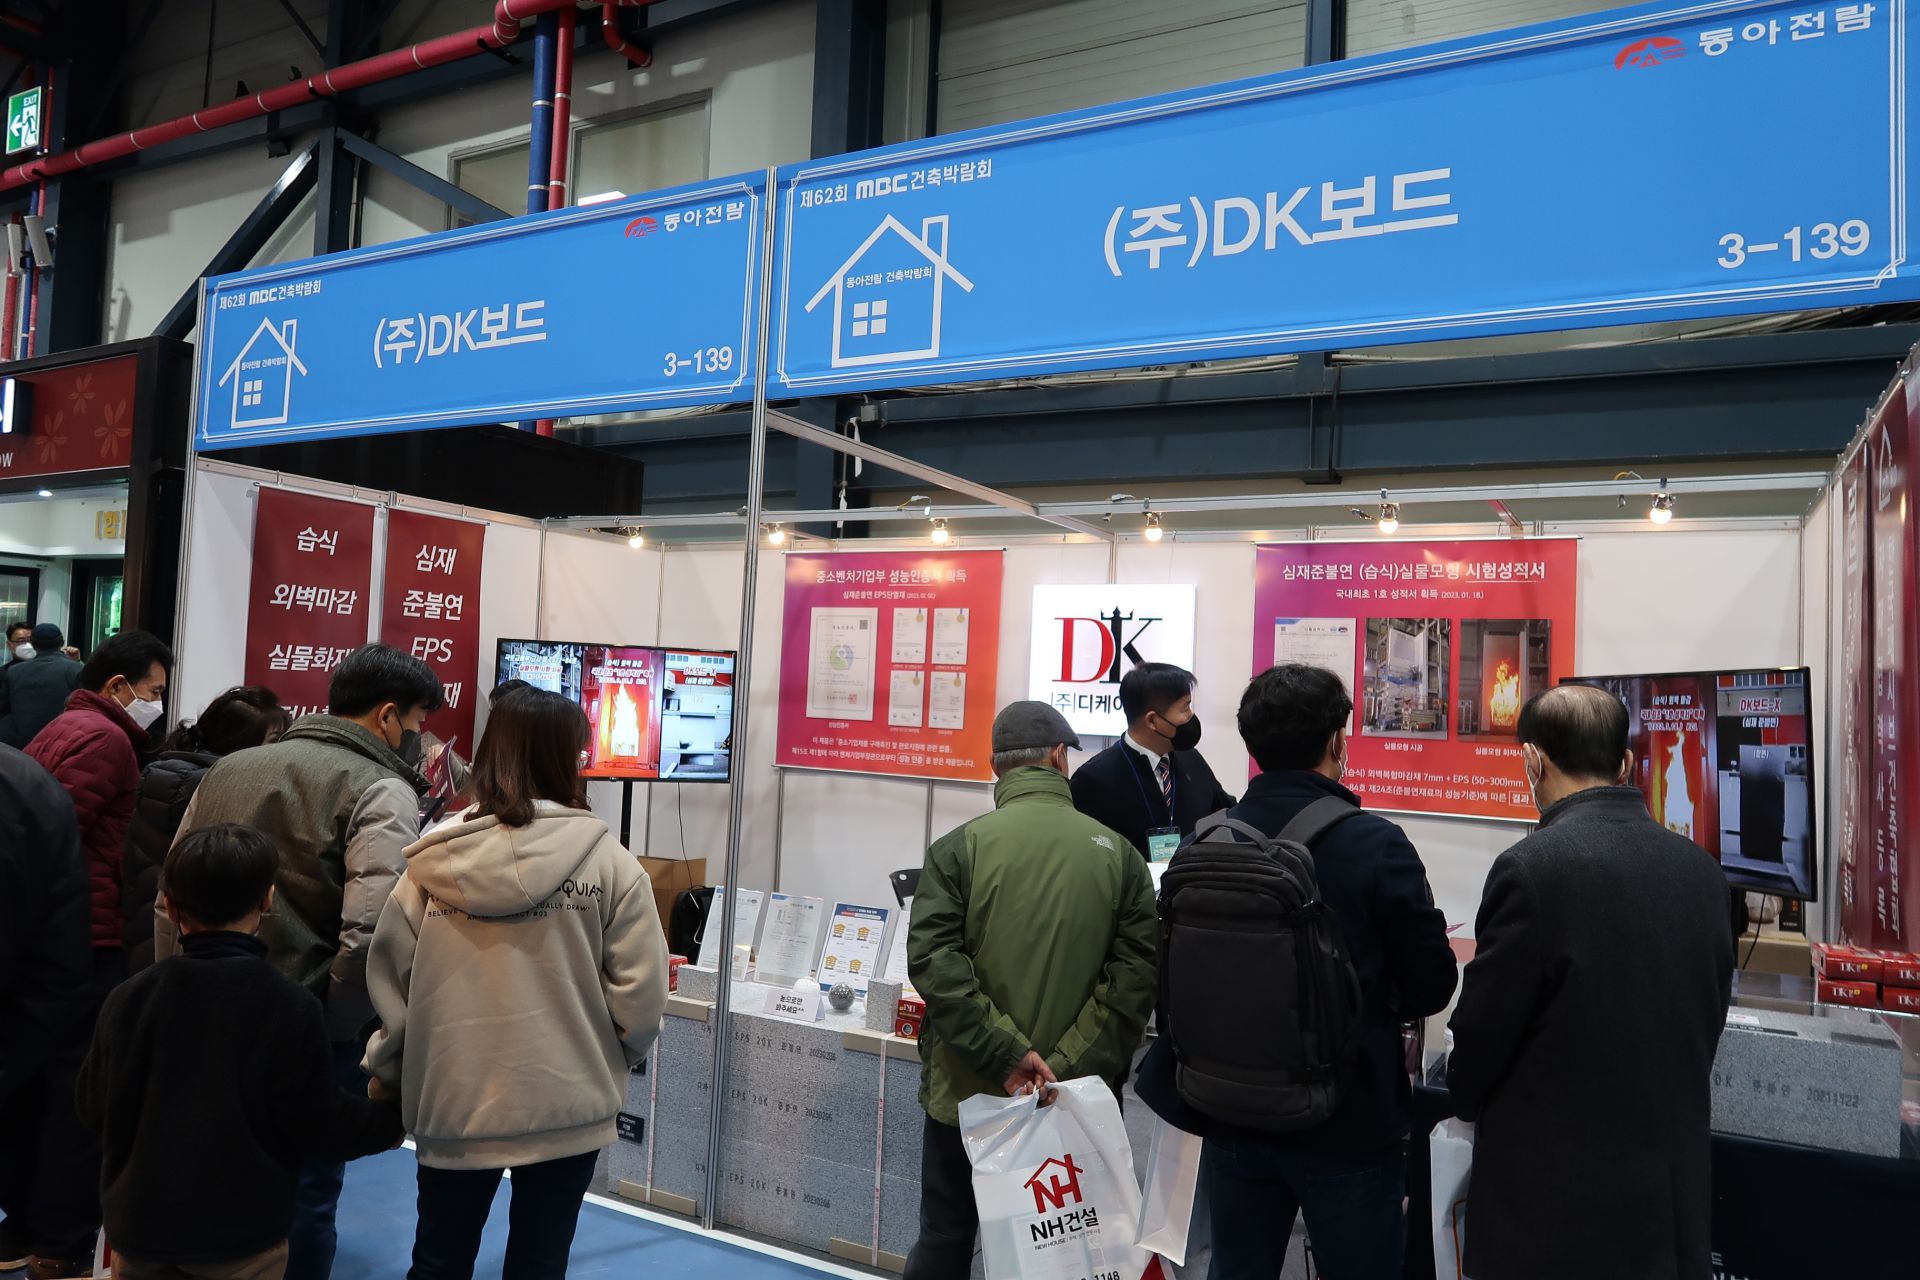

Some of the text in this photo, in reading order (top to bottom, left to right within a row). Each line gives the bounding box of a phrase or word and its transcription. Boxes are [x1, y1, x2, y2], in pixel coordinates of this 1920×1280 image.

[1697, 3, 1876, 57] 동아전람
[23, 94, 38, 107] EXIT
[800, 184, 848, 209] 제62회
[664, 203, 745, 232] 동아전람
[1102, 166, 1459, 278] (주)DK보드
[1717, 219, 1872, 269] 3-139
[846, 265, 933, 289] 동아전람 건축박람회
[219, 293, 246, 309] 제62회
[373, 300, 548, 369] (주)DK보드
[664, 346, 734, 377] 3-139
[297, 526, 339, 555] 습식
[415, 544, 457, 575] 심재
[1282, 561, 1546, 581] 심재준불연 (습식)실물모형 시험성적서
[816, 569, 886, 584] 중소벤처기업부
[269, 583, 358, 615] 외벽마감
[402, 589, 464, 621] 준불연
[1335, 588, 1370, 600] 국내최초
[1374, 588, 1387, 600] 1호
[1390, 588, 1417, 600] 성적서
[410, 636, 453, 663] EPS
[1739, 697, 1781, 713] DK보드-X
[1383, 742, 1409, 752] 실물모형
[1502, 747, 1524, 757] 화재시
[1424, 771, 1444, 782] 7mm
[1453, 774, 1469, 784] EPS
[1029, 1207, 1099, 1242] NH건설
[1048, 1237, 1066, 1248] HOUSE
